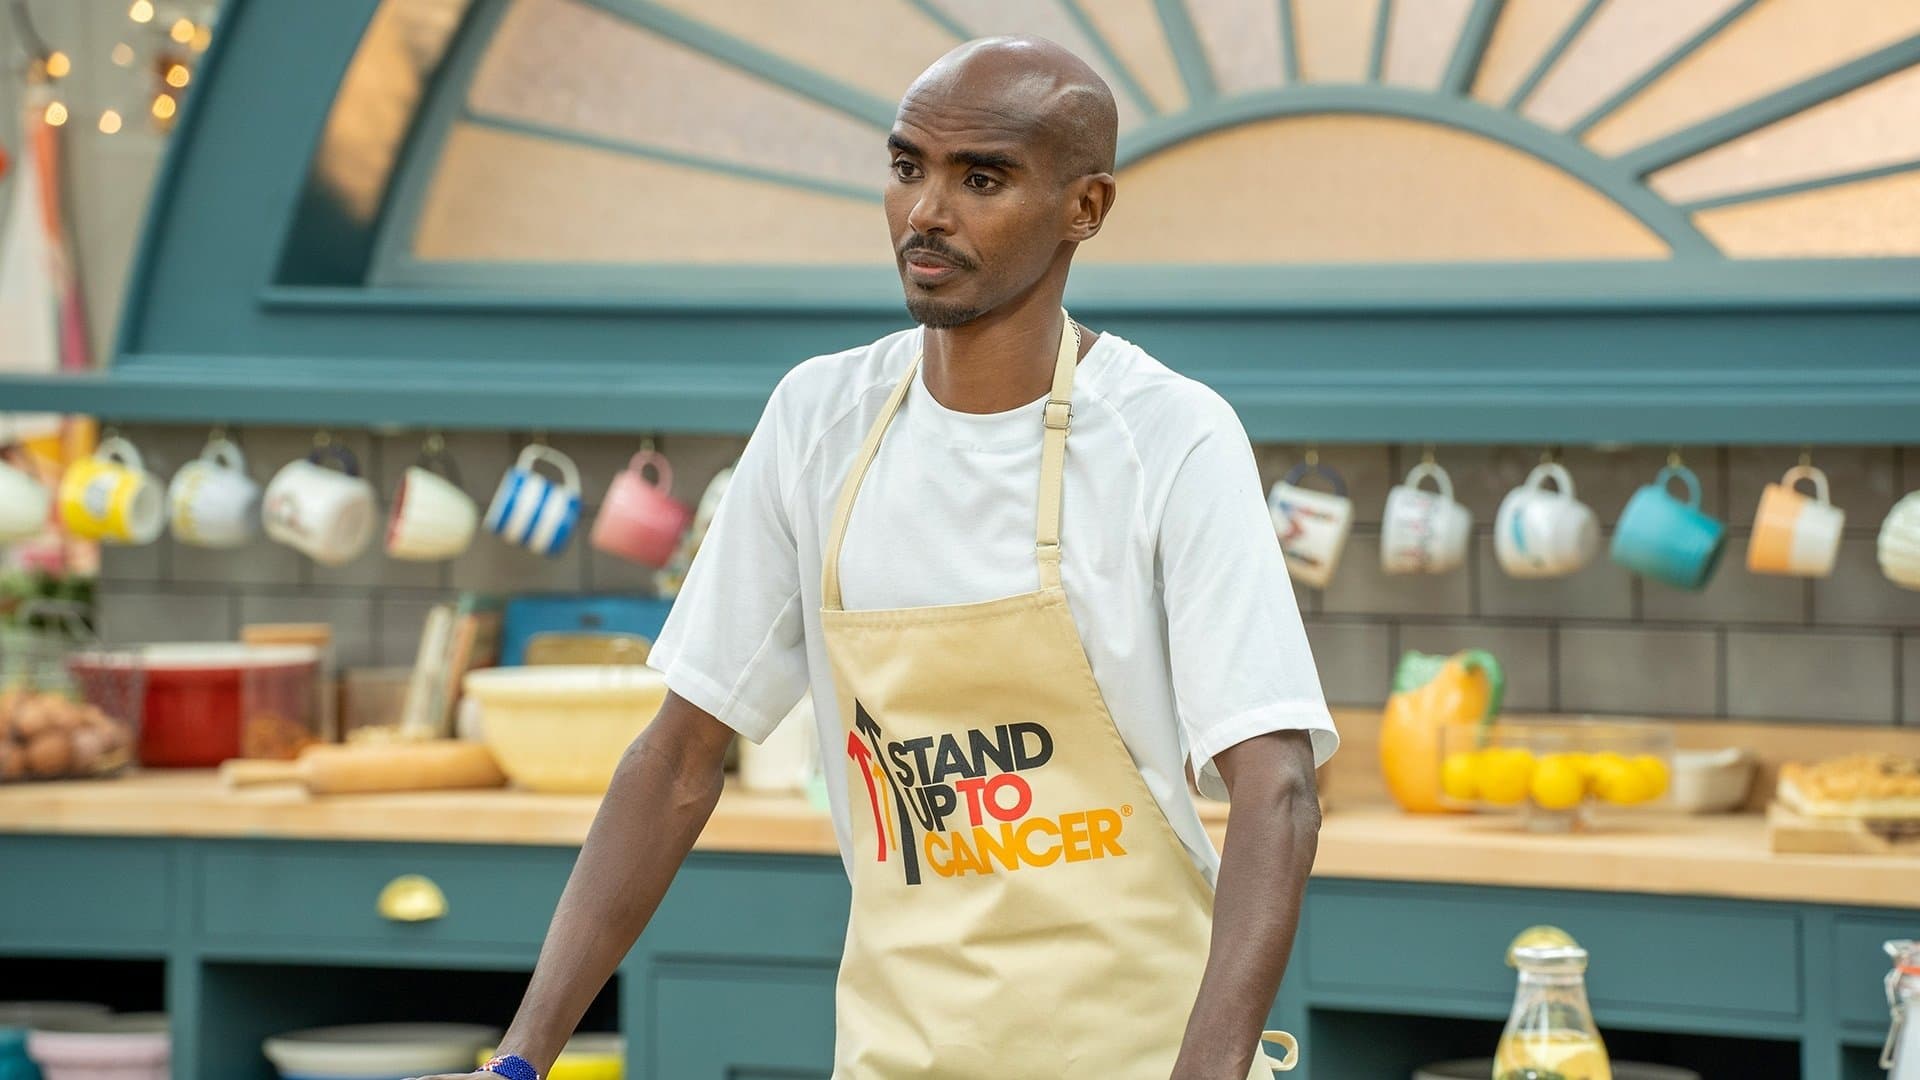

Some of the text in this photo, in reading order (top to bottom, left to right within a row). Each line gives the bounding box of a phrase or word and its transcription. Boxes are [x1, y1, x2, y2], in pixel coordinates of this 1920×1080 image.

[888, 722, 1053, 787] STAND
[904, 773, 1033, 831] UP TO
